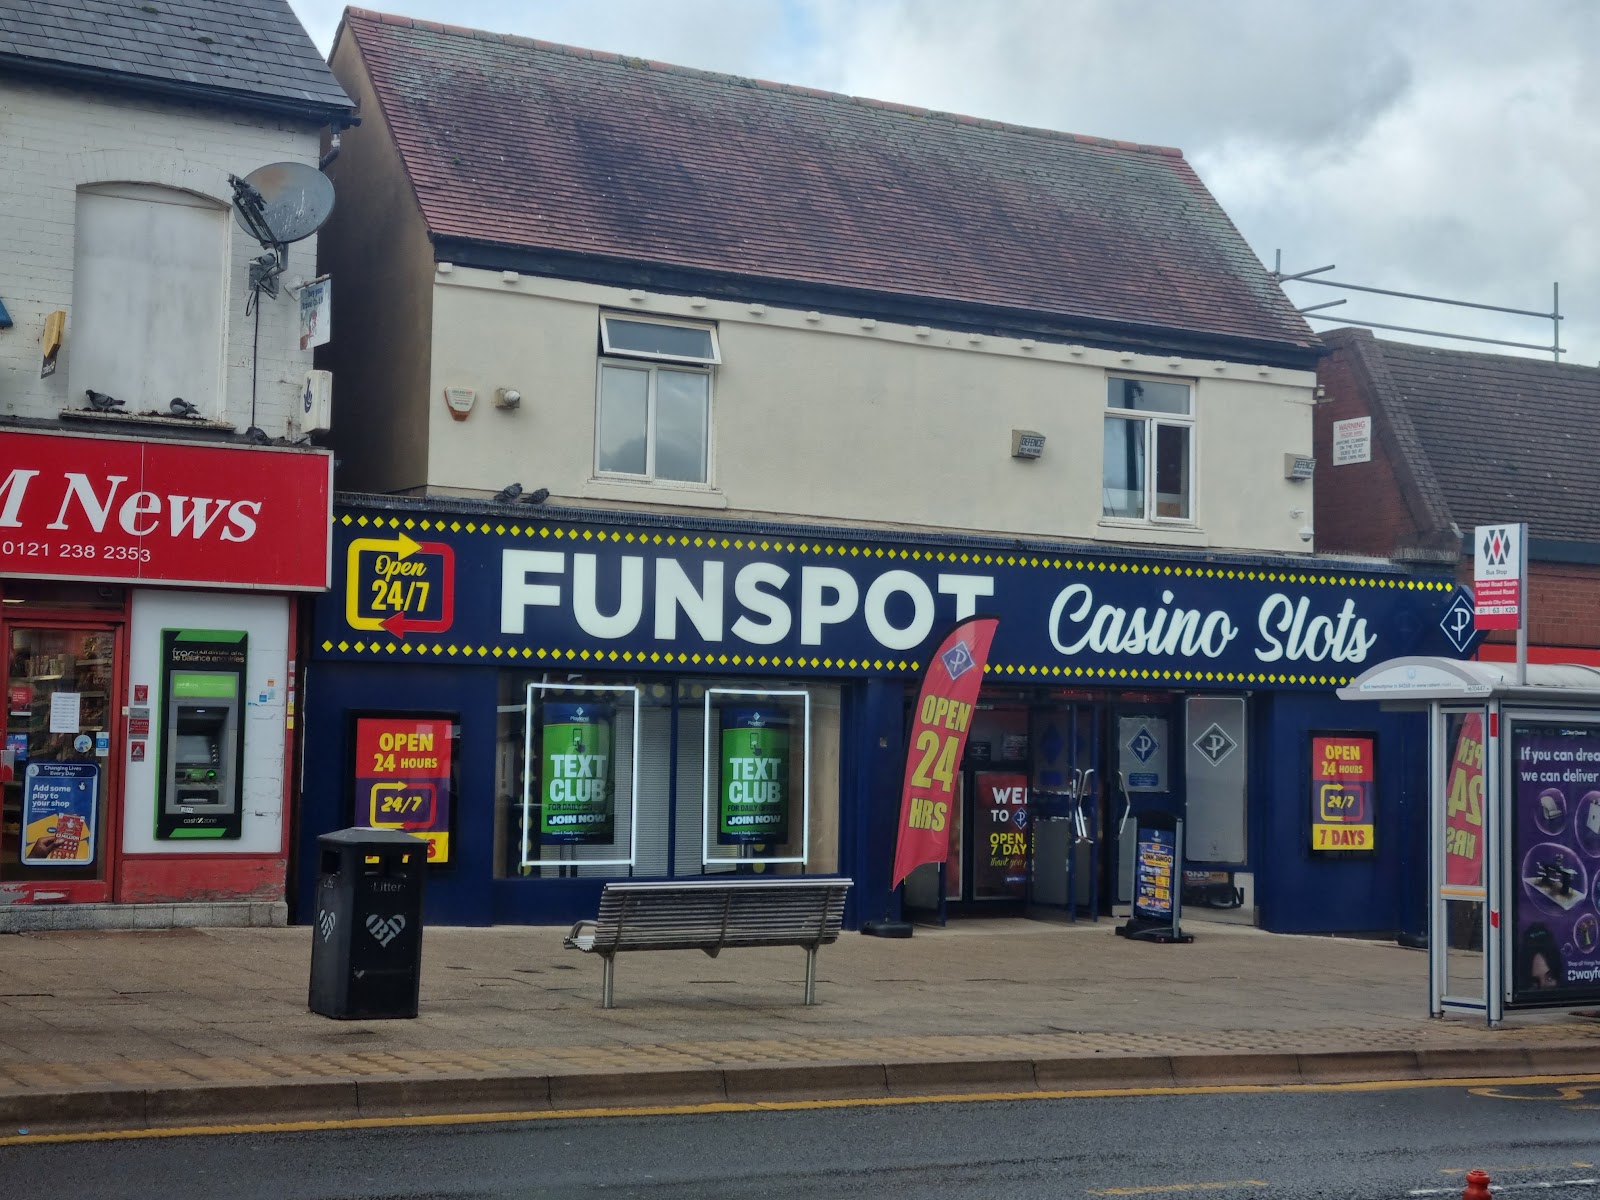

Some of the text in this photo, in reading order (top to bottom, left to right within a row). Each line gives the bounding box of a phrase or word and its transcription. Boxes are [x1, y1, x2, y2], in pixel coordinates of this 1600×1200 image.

[1339, 420, 1366, 431] WARNING
[1021, 437, 1045, 447] DEFENCE
[46, 472, 262, 543] News
[2, 541, 151, 562] 0121 238 2353
[375, 554, 427, 582] Open
[371, 579, 430, 612] 24/7
[500, 548, 995, 651] FUNSPOT
[1048, 583, 1377, 663] Casino Slots
[920, 694, 971, 733] OPEN
[379, 733, 433, 753] OPEN
[911, 730, 959, 793] 24
[1325, 745, 1360, 760] OPEN
[1521, 746, 1531, 760] If
[1532, 751, 1551, 765] you
[1553, 751, 1574, 761] can
[373, 753, 438, 772] 24 HOURS
[550, 754, 606, 778] TEXT
[730, 758, 781, 780] TEXT
[1321, 761, 1363, 776] 24 HOURS
[1521, 768, 1599, 782] we can deliver
[32, 792, 49, 800] play
[549, 779, 606, 802] CLUB
[729, 781, 781, 803] CLUB
[51, 800, 70, 808] shop
[381, 796, 422, 814] 24/7
[740, 804, 757, 812] DAILY
[1327, 795, 1355, 809] 24/7
[549, 814, 606, 825] JOIN NOW
[728, 815, 781, 825] JOIN NOW
[908, 798, 947, 832] HRS
[990, 809, 1009, 822] TO
[990, 833, 1024, 845] OPEN
[1320, 830, 1365, 845] 7 DAYS
[990, 844, 998, 855] 7
[373, 882, 401, 892] Litter
